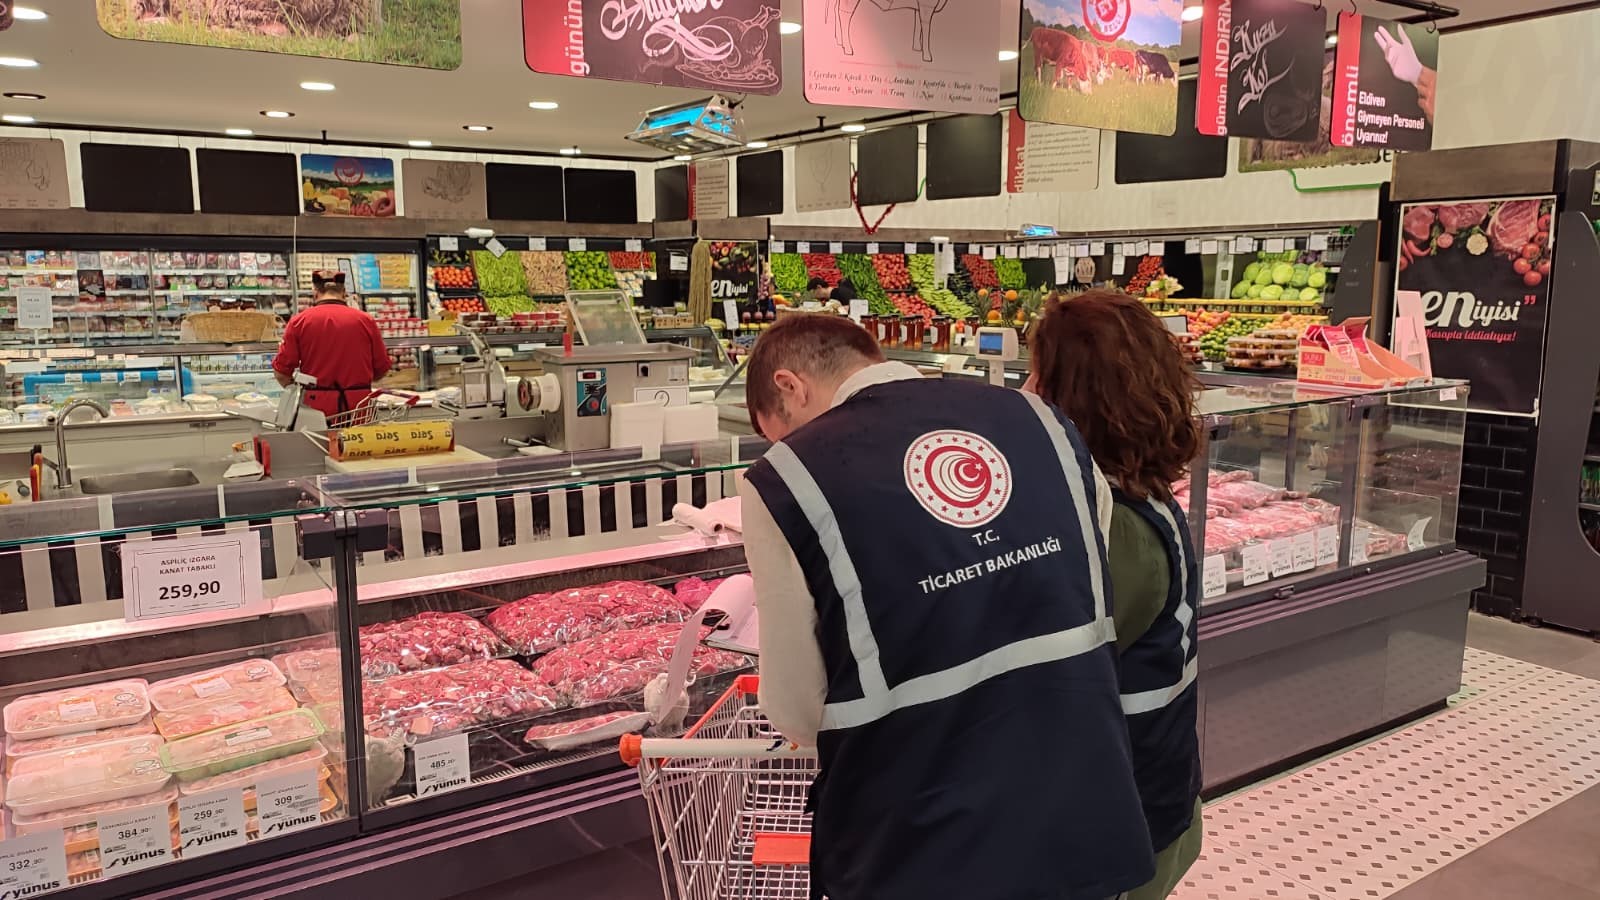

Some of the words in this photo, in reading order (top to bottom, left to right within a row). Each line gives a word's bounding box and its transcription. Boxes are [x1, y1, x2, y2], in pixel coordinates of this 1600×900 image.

[1341, 65, 1359, 147] önemli
[1358, 91, 1386, 108] Eldiven
[1215, 84, 1228, 136] günün
[1392, 114, 1425, 130] Personeli
[1013, 147, 1025, 193] dikkat
[711, 279, 732, 297] en
[1421, 290, 1476, 328] en
[972, 529, 1001, 546] T.C.
[159, 567, 185, 575] KANAT
[918, 562, 983, 594] TİCARET
[985, 536, 1062, 573] BAKANLIĞI
[159, 580, 221, 600] 259,90
[432, 777, 466, 792] yunus
[277, 814, 317, 831] yunus
[196, 828, 238, 846] yunus
[121, 848, 166, 866] yunus
[12, 880, 60, 899] yunus
